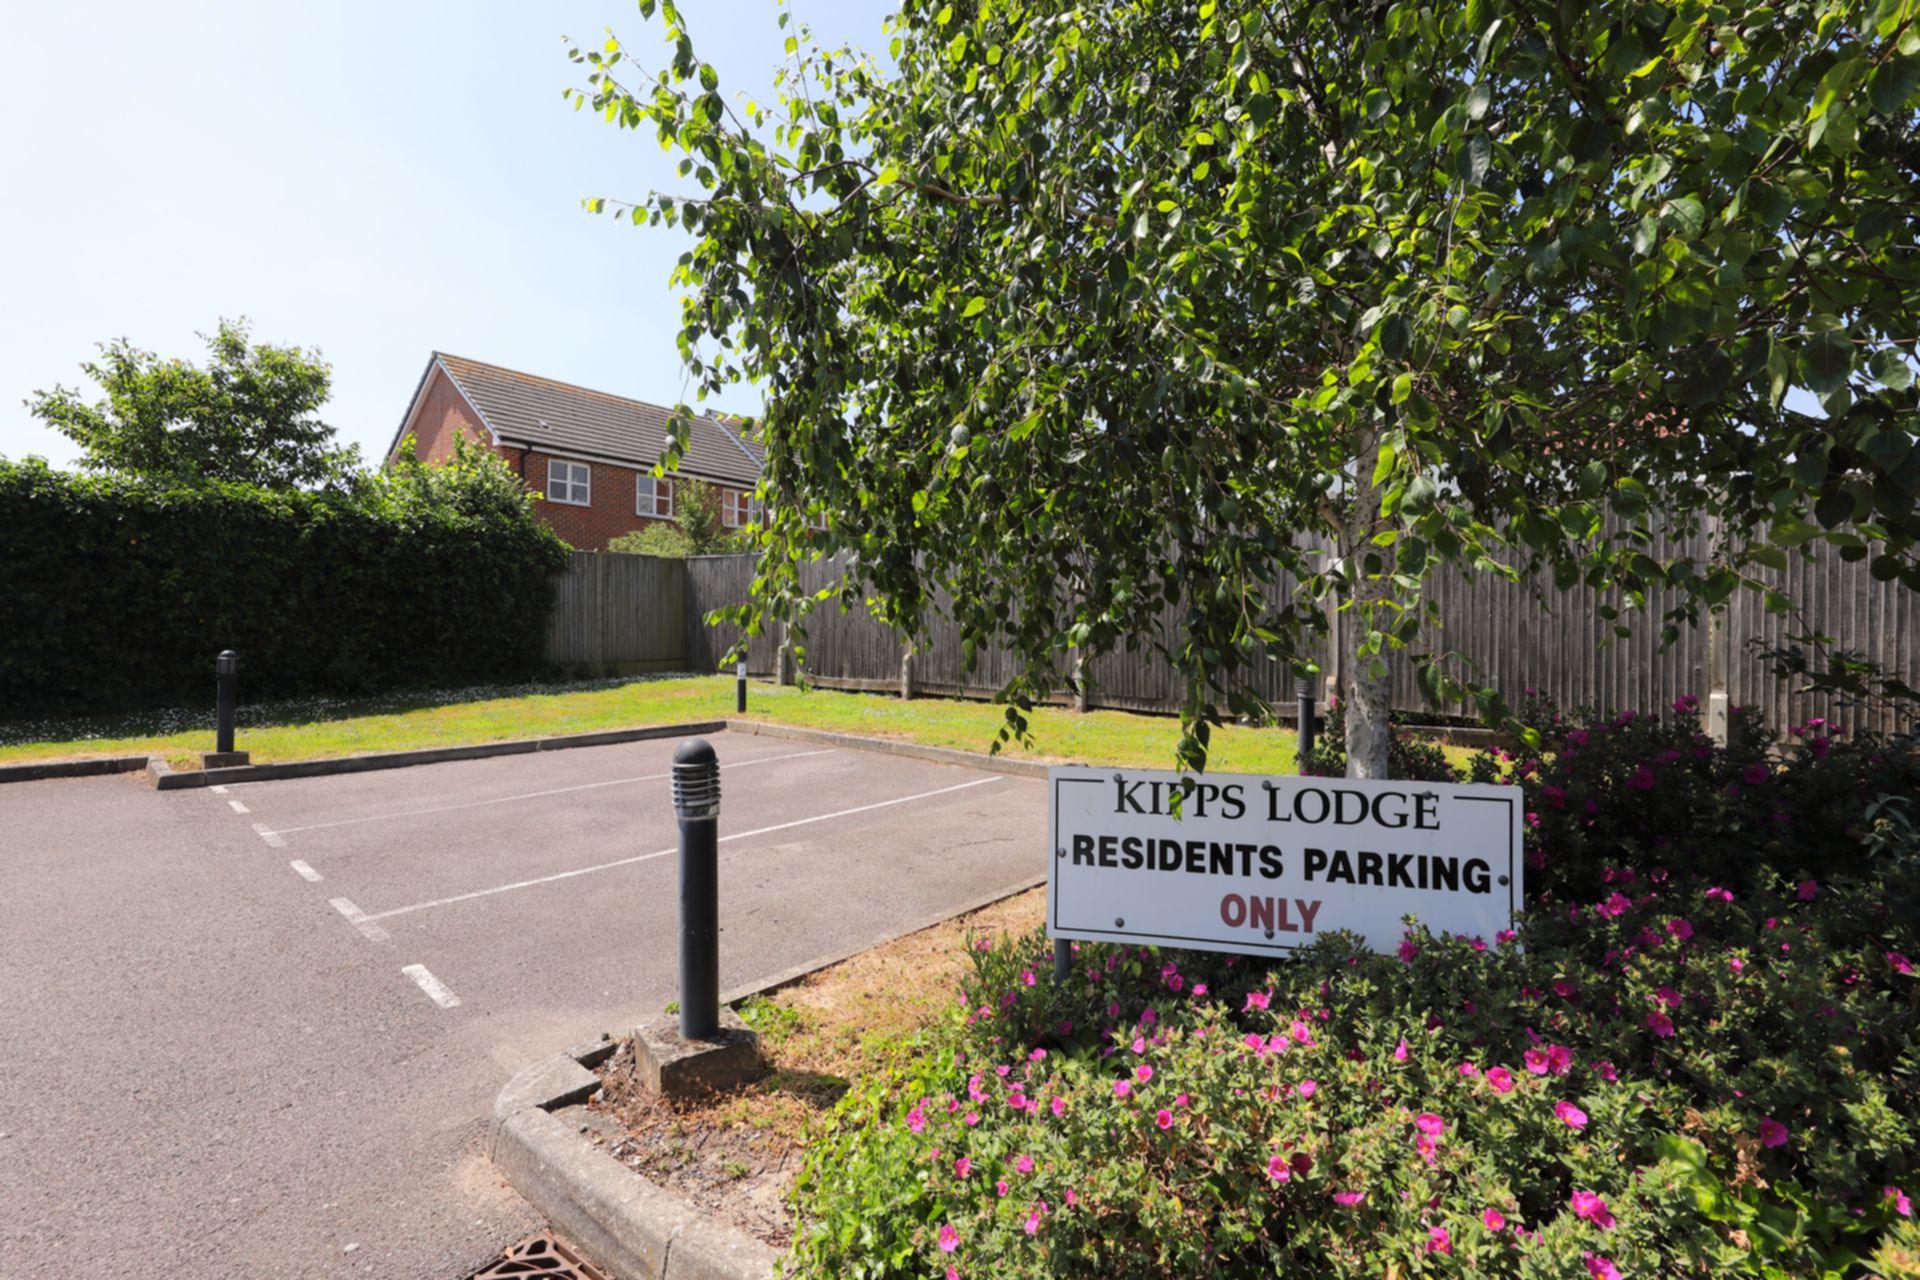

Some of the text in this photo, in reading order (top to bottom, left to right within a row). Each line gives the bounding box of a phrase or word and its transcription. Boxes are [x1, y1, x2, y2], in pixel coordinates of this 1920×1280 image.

[1267, 787, 1441, 830] LODGE
[1072, 834, 1492, 894] RESIDENTS PARKING
[1220, 893, 1323, 934] ONLY
